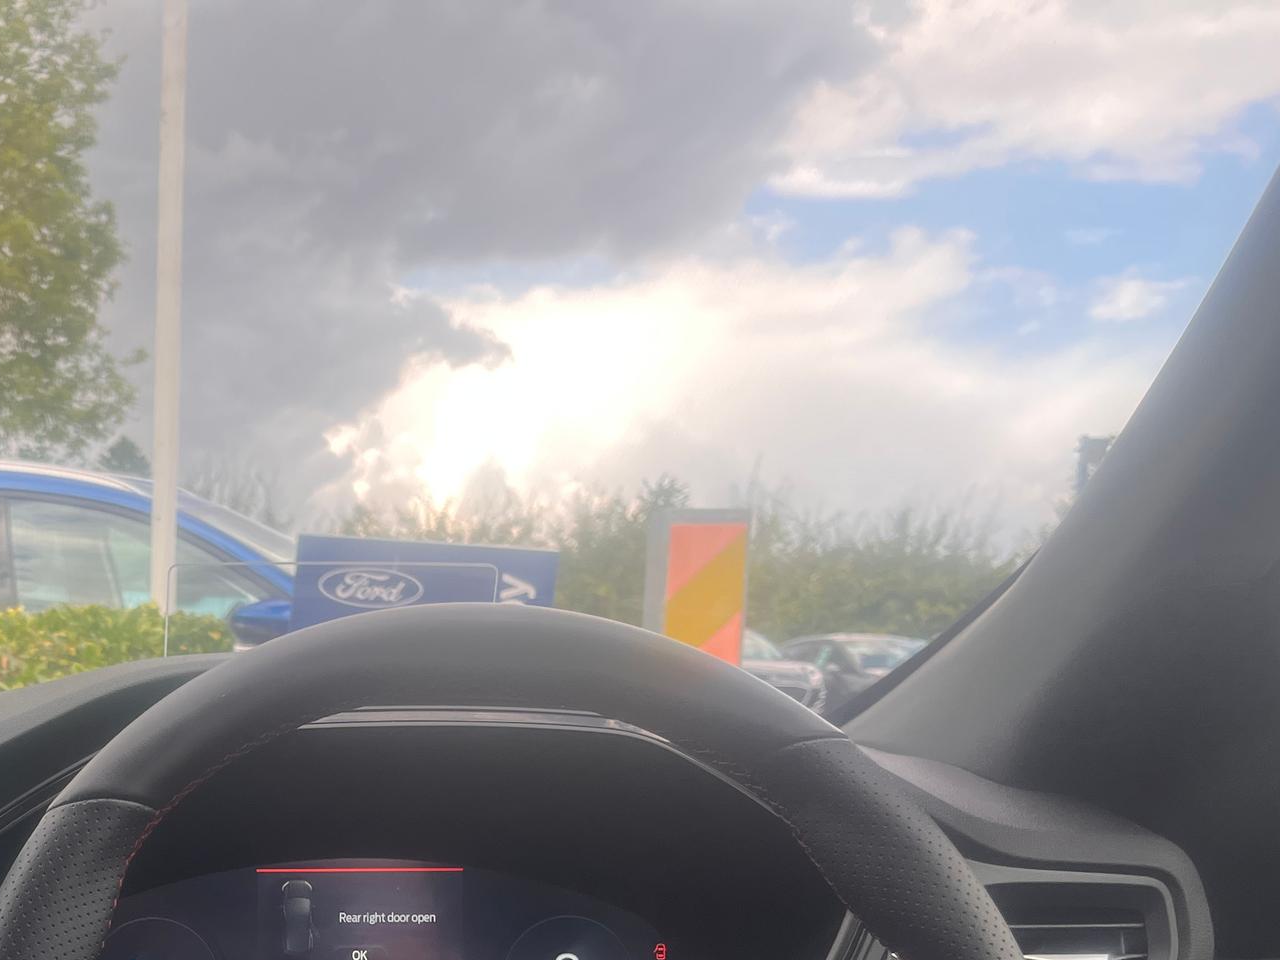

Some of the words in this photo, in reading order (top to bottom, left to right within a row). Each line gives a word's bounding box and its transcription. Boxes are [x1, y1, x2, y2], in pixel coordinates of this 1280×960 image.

[335, 571, 405, 602] Ford
[339, 912, 362, 923] Rear
[362, 911, 386, 925] right
[387, 911, 411, 923] door
[411, 914, 436, 925] open
[351, 950, 368, 960] OK
